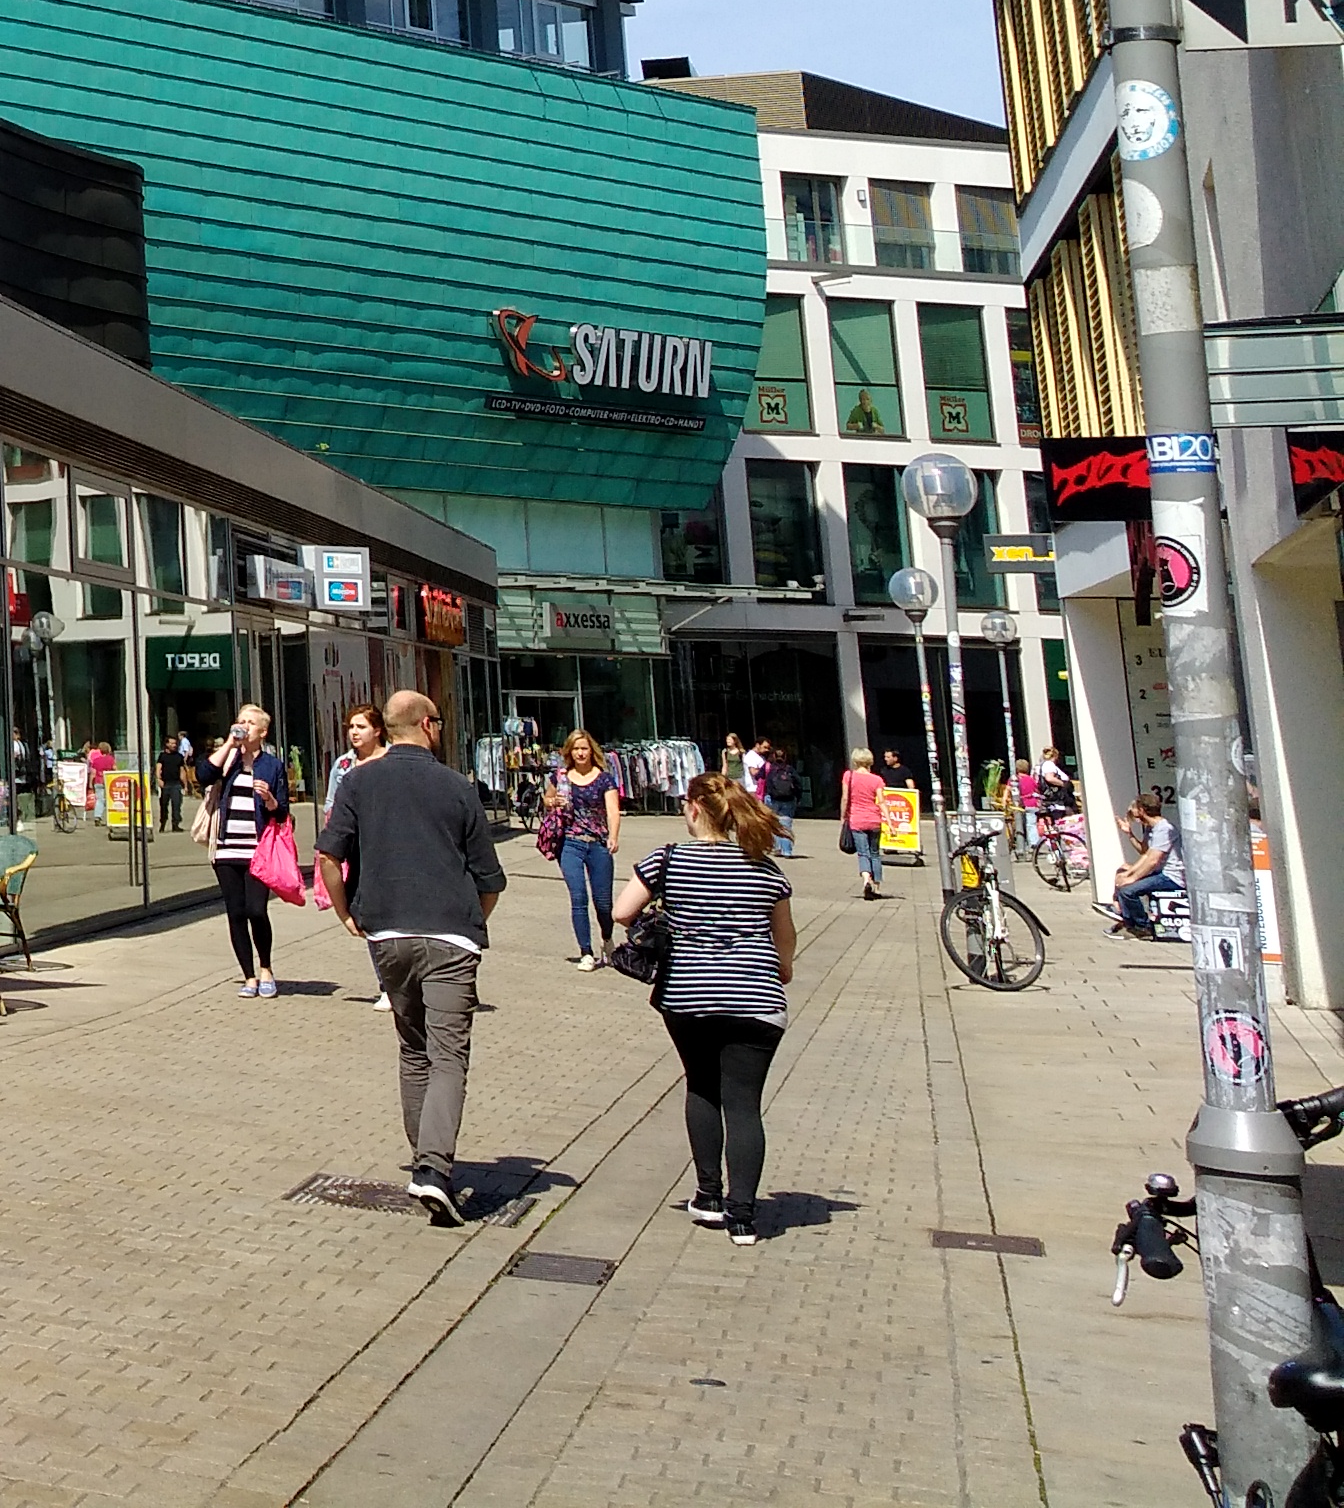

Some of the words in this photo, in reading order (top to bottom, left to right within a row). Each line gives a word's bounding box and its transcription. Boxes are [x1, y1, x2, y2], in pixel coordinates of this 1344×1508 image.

[572, 323, 712, 398] SATURN
[556, 612, 611, 630] axxessa
[1135, 654, 1143, 666] 3
[1139, 689, 1147, 700] 2
[1143, 723, 1150, 734] 1
[1147, 758, 1156, 769] E
[1150, 785, 1176, 804] 32
